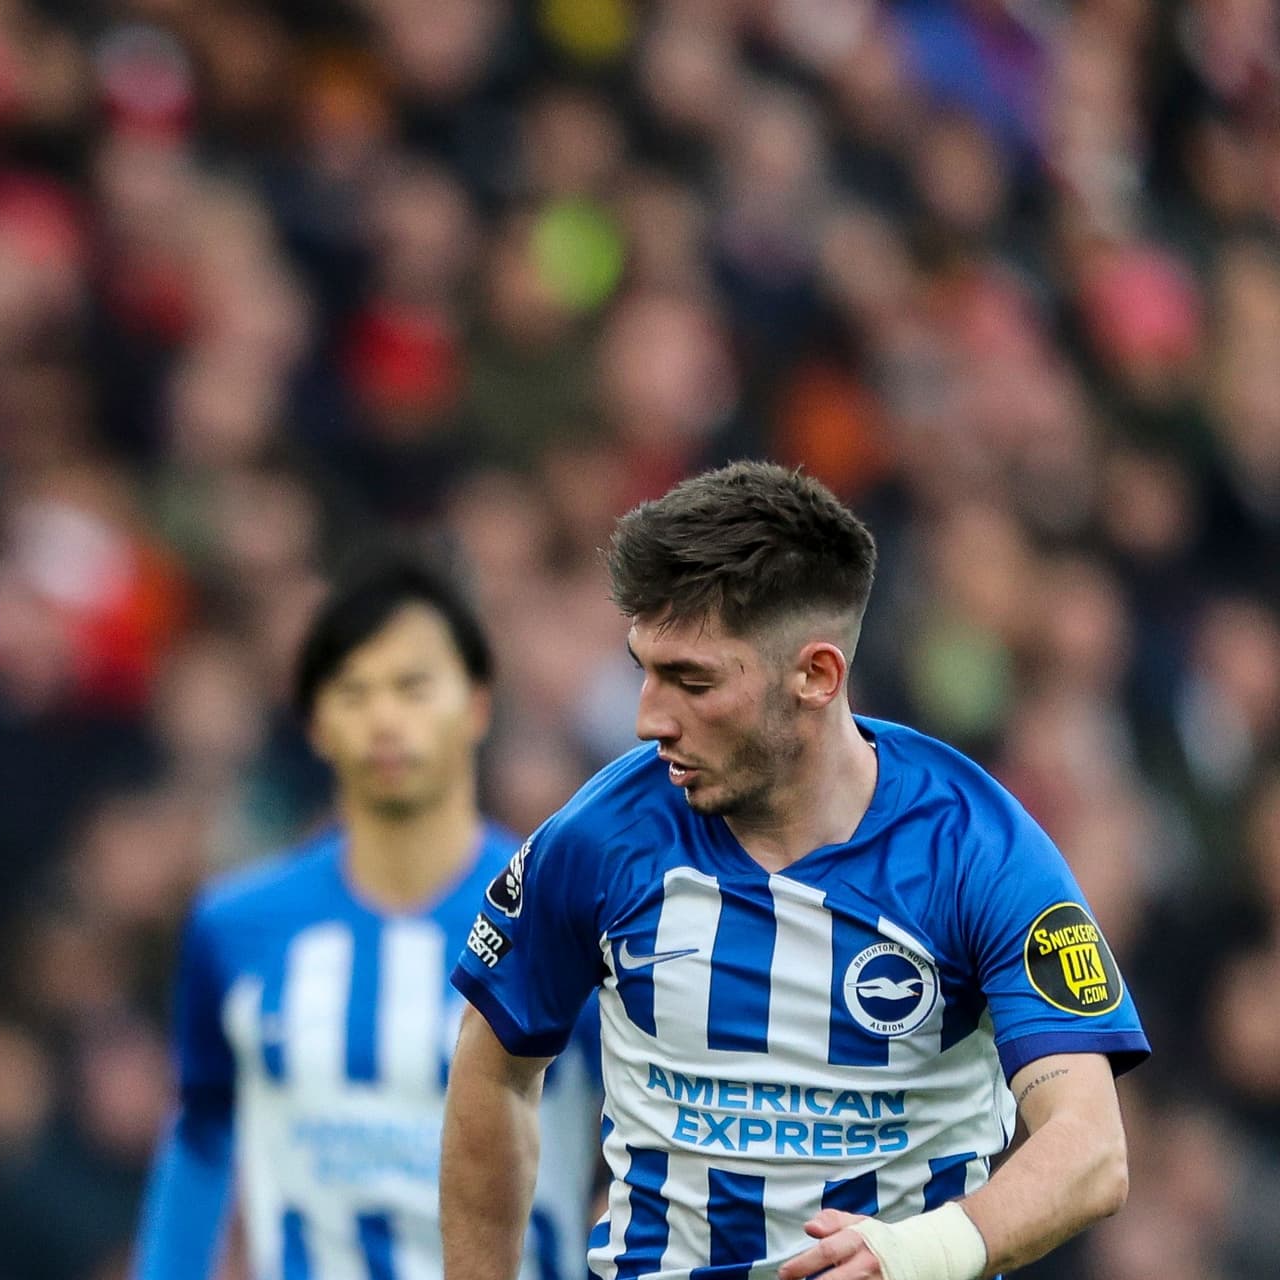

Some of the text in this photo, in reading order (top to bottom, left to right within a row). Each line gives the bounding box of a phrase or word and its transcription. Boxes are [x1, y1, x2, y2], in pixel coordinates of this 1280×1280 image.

[854, 944, 895, 969] BRIGHTON
[908, 950, 927, 971] HOVE
[1065, 948, 1101, 983] UK
[1081, 985, 1108, 1005] .COM
[870, 1021, 905, 1032] ALBION
[646, 1062, 908, 1120] AMERICAN
[672, 1105, 909, 1157] EXPRESS
